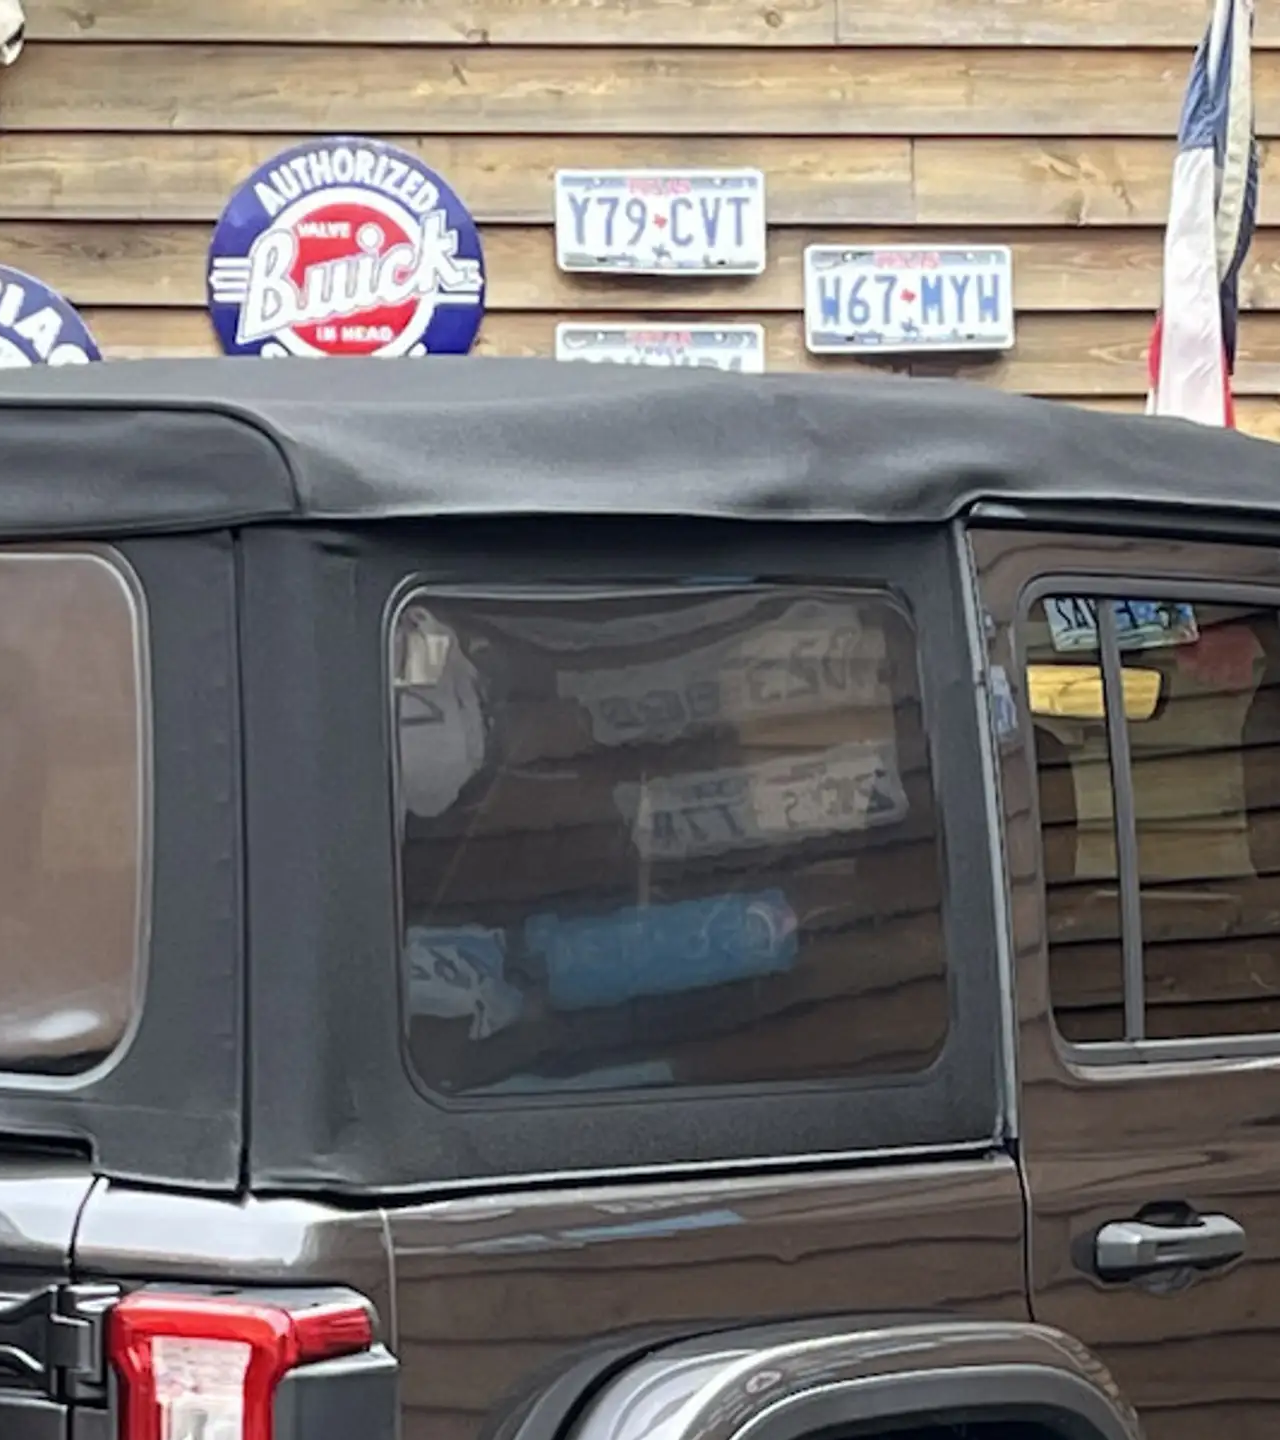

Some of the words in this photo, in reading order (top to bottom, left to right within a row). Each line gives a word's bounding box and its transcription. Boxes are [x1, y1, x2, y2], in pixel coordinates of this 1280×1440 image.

[253, 147, 440, 216] AUTHORIZED
[670, 196, 750, 247] CVT
[236, 209, 477, 344] Buick
[340, 325, 394, 343] HEAD
